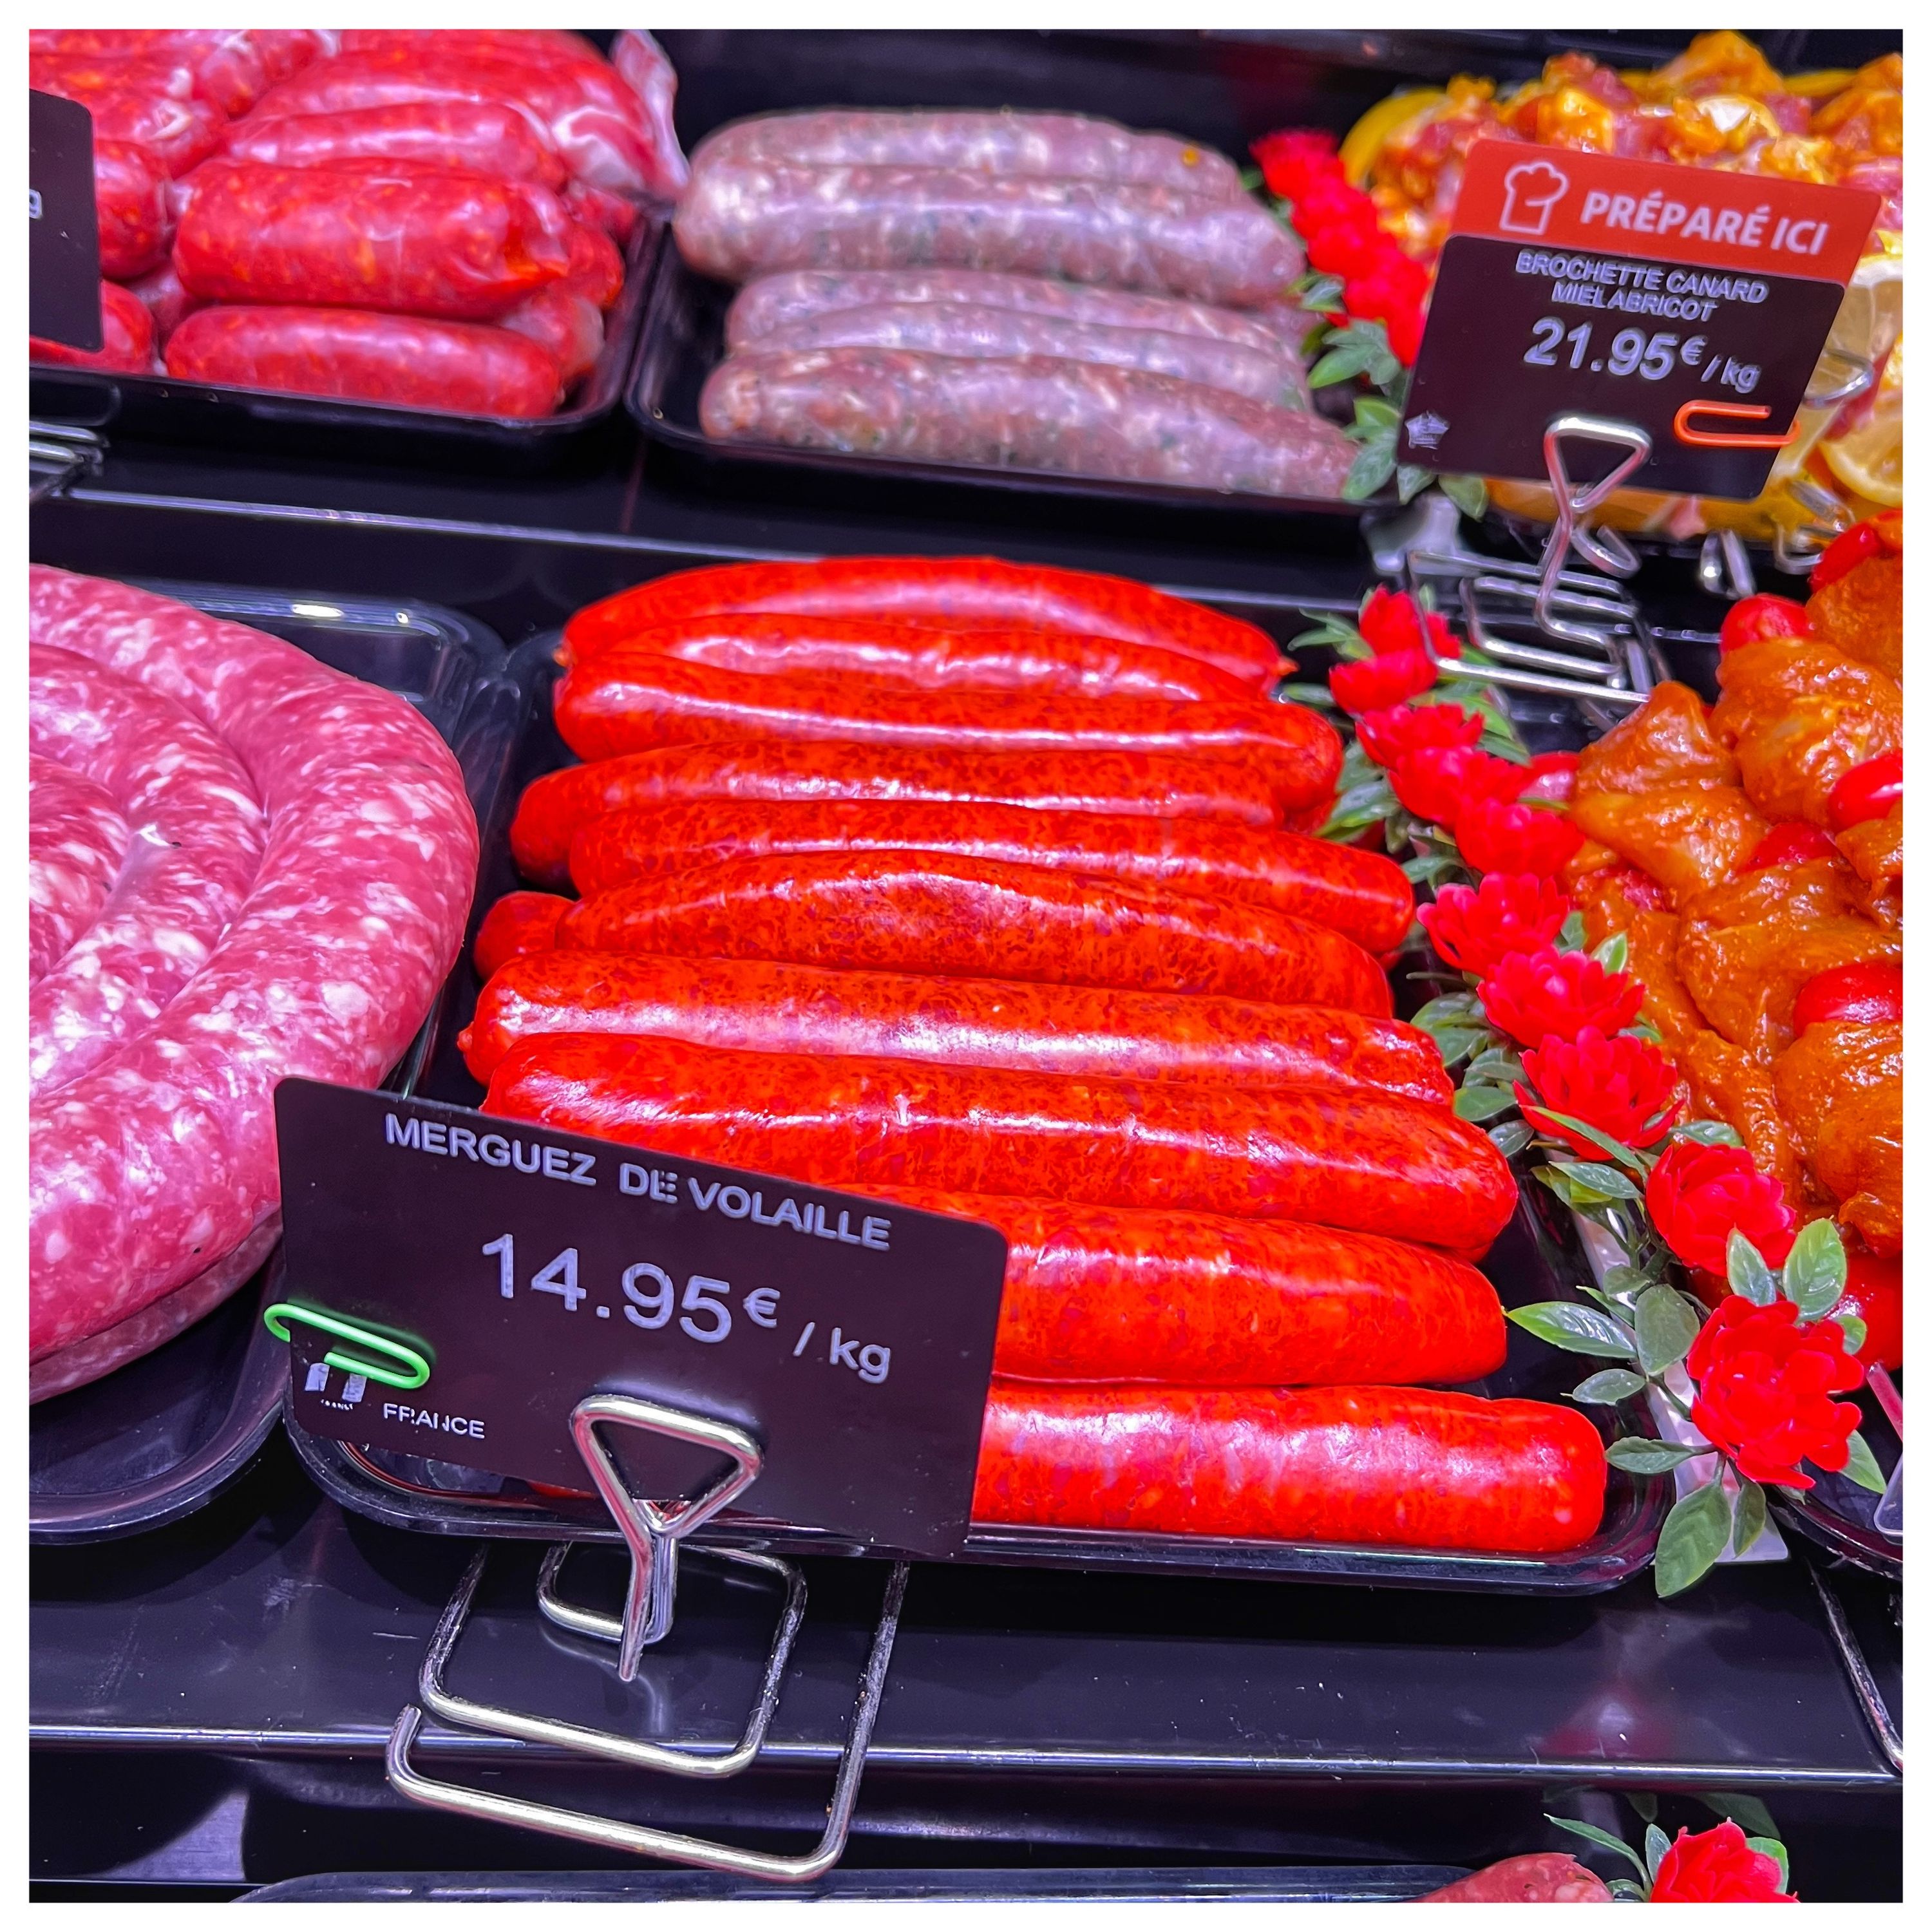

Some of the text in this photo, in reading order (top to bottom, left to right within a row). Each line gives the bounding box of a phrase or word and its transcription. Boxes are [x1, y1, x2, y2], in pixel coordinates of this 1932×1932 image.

[1580, 190, 1829, 256] PRÉPARÉ ICI
[1515, 249, 1769, 303] BROCHETTE CANARD
[386, 1113, 892, 1251] MERGUEZ DE VOLAILLE
[383, 1403, 485, 1439] FRANCE
